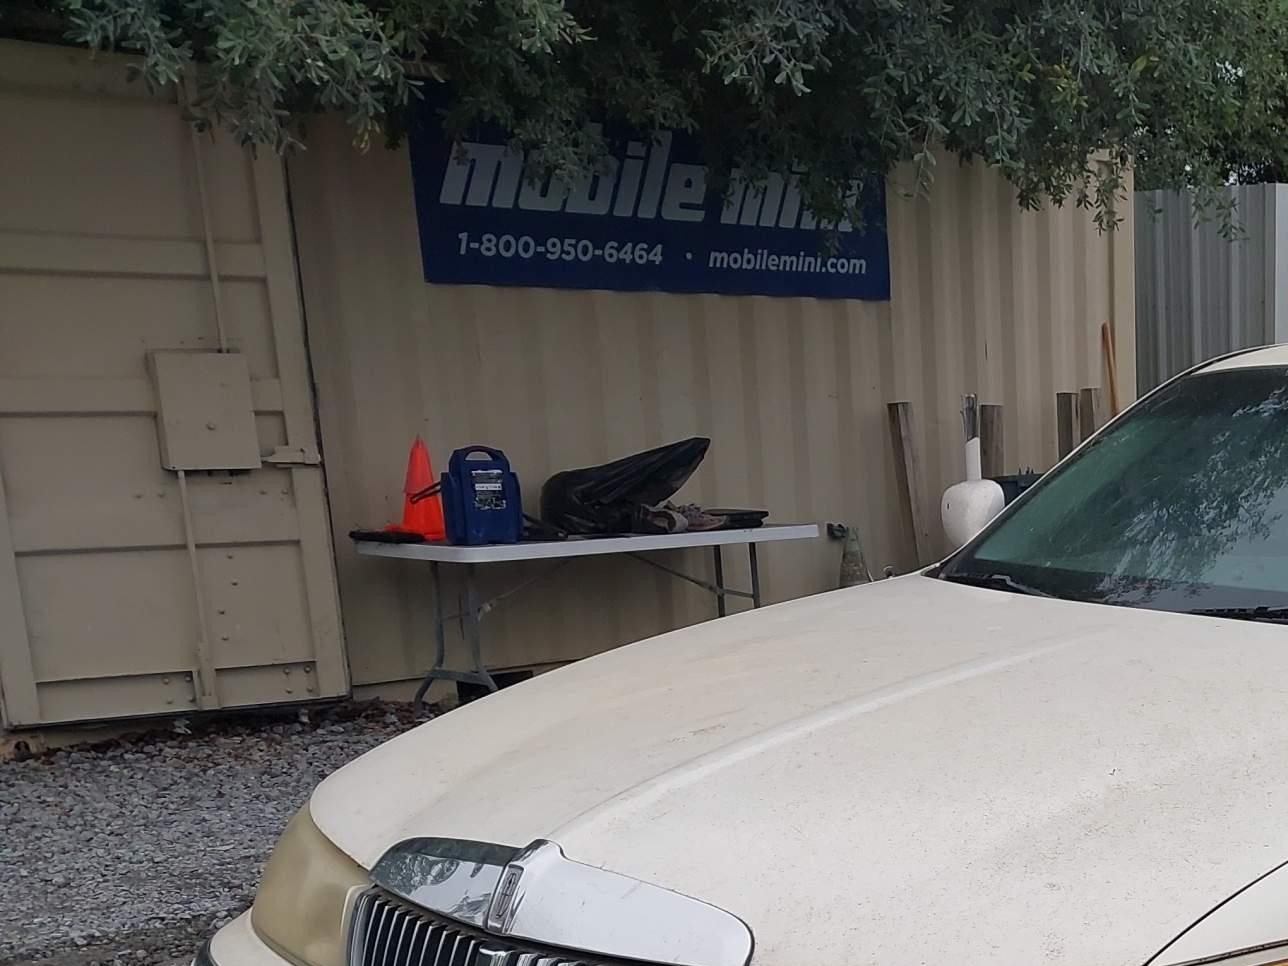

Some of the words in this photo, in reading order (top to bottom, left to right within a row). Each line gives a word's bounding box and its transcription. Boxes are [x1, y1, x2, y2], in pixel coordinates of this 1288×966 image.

[439, 121, 707, 222] mobile
[457, 231, 663, 265] 1-800-950-6464
[708, 248, 867, 274] mobilemini.com
